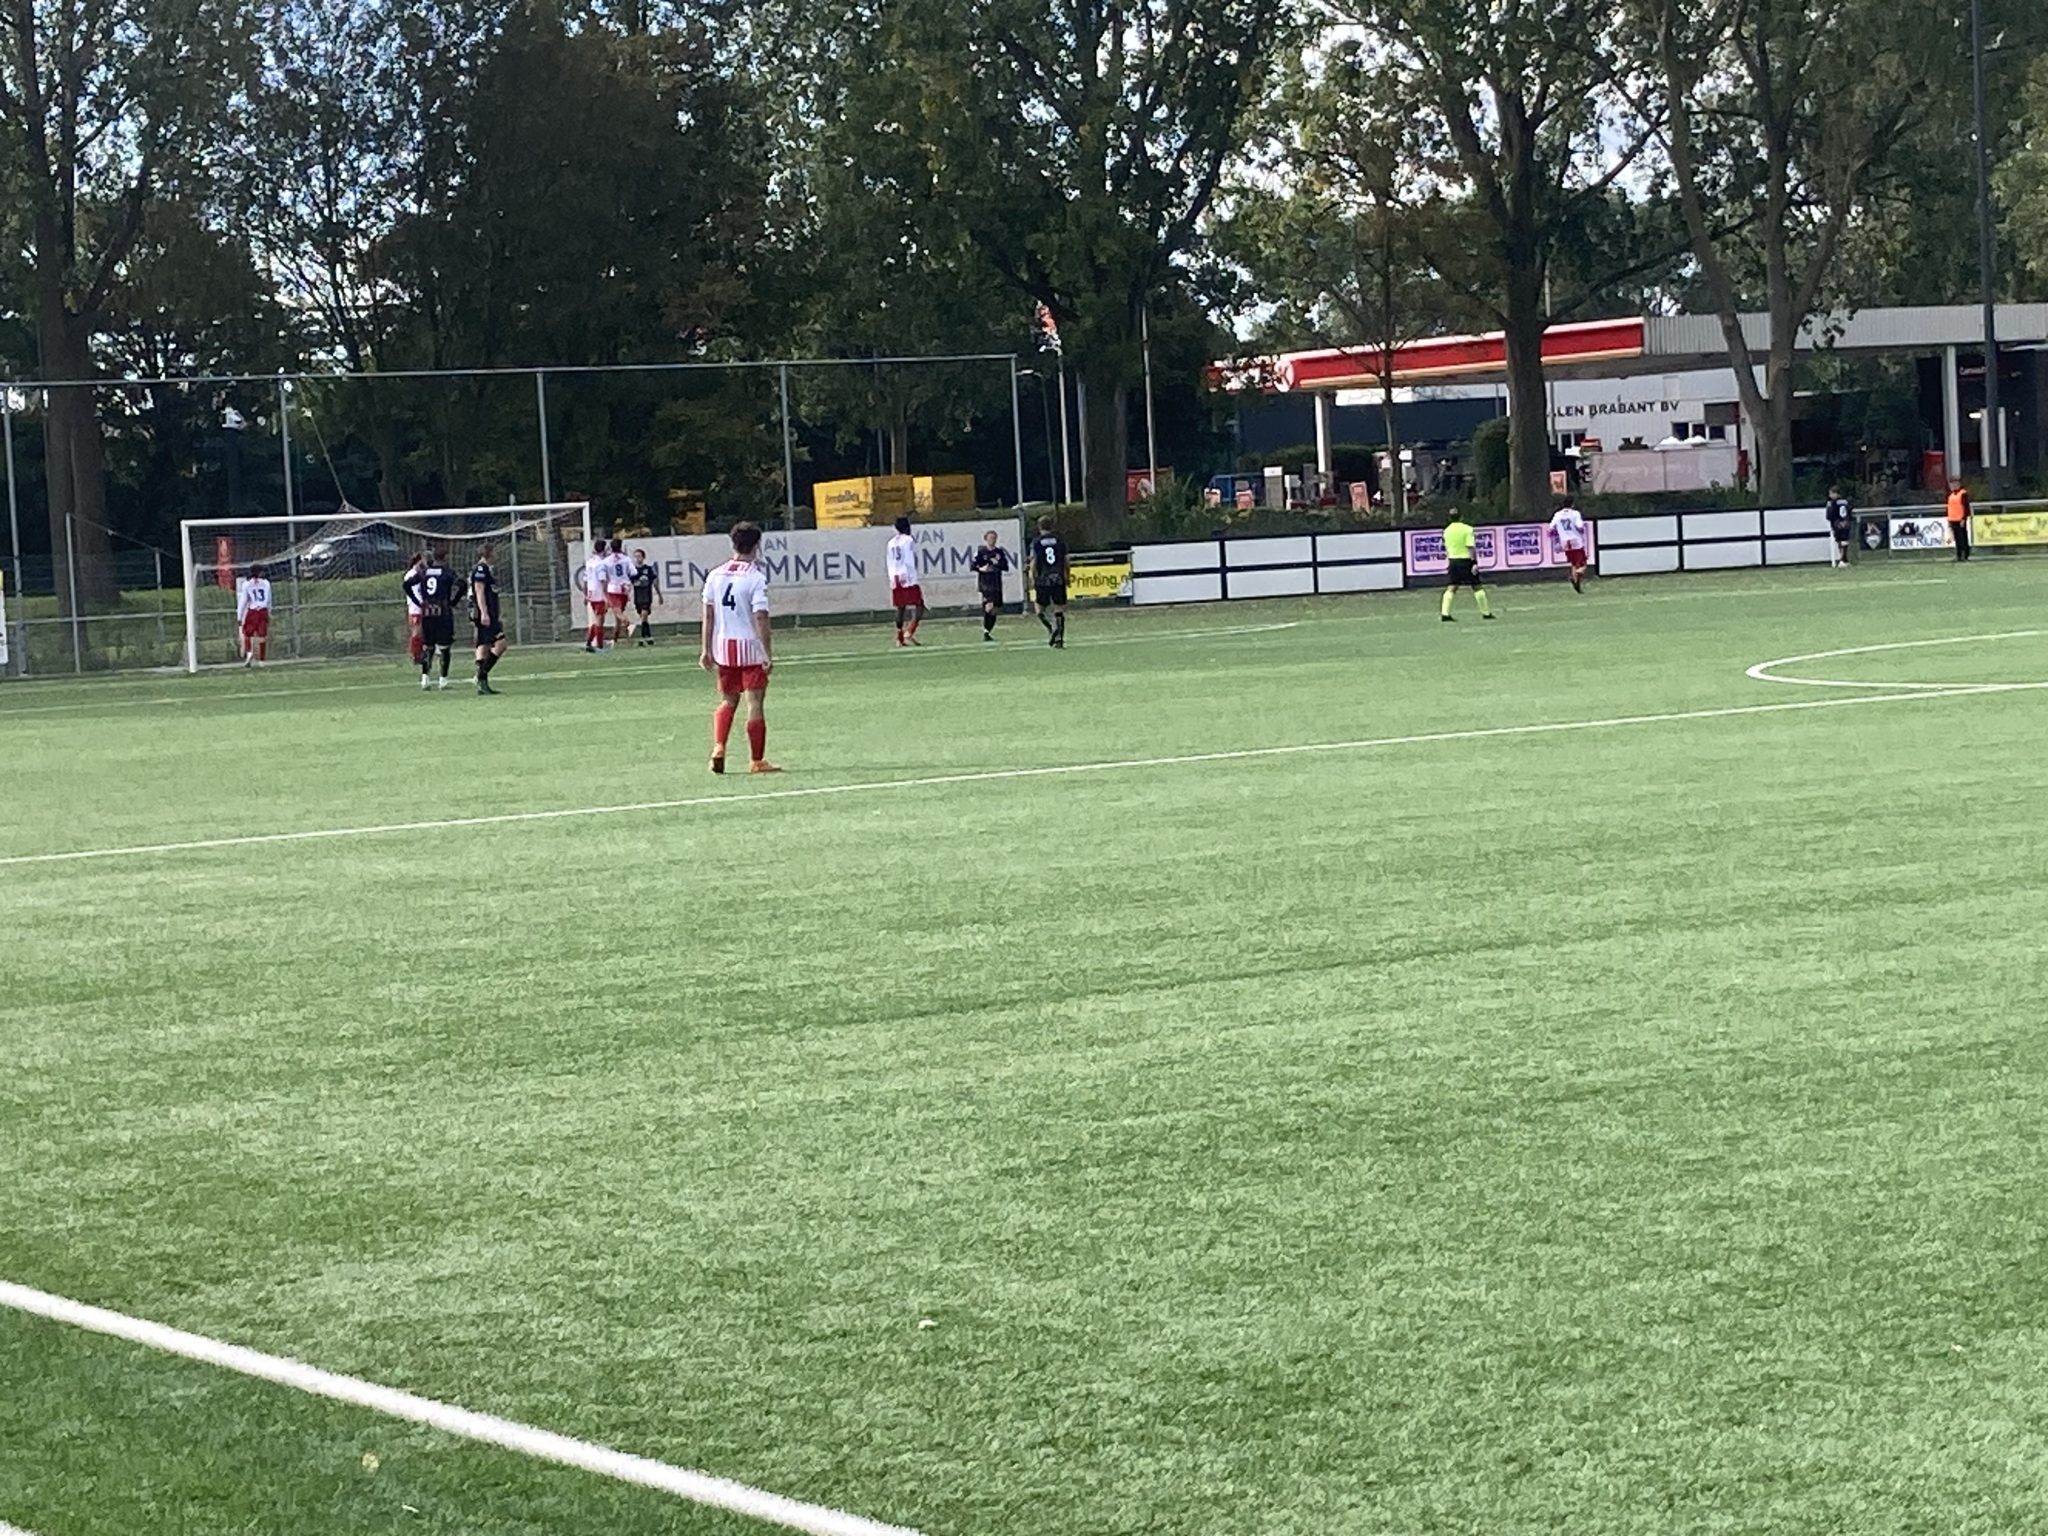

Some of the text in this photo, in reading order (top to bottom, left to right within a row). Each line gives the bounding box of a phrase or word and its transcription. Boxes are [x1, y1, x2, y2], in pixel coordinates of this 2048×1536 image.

[1589, 401, 1655, 418] BRABANT
[1660, 399, 1680, 412] BV
[763, 536, 788, 552] AN
[911, 529, 945, 545] VAN
[913, 546, 1019, 575] MMN
[1045, 546, 1056, 565] 8
[754, 551, 866, 585] MMEN
[252, 588, 266, 602] 13
[426, 576, 438, 596] 9
[721, 582, 736, 611] 4
